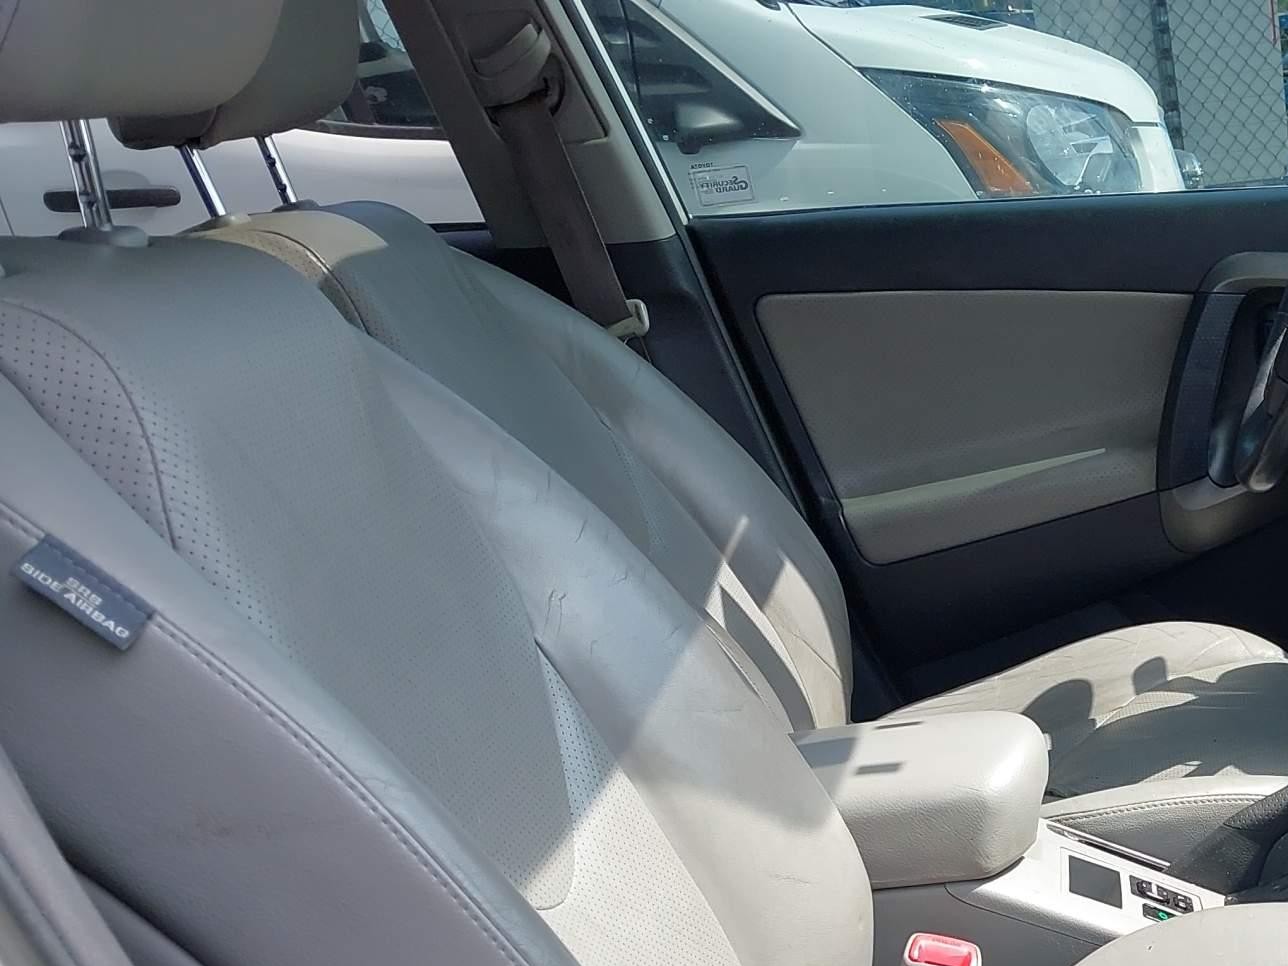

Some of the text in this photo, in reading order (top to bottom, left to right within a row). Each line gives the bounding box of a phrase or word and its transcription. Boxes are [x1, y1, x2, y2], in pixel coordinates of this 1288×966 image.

[20, 562, 131, 639] SIDE AIRBAG
[65, 576, 103, 606] SRS
